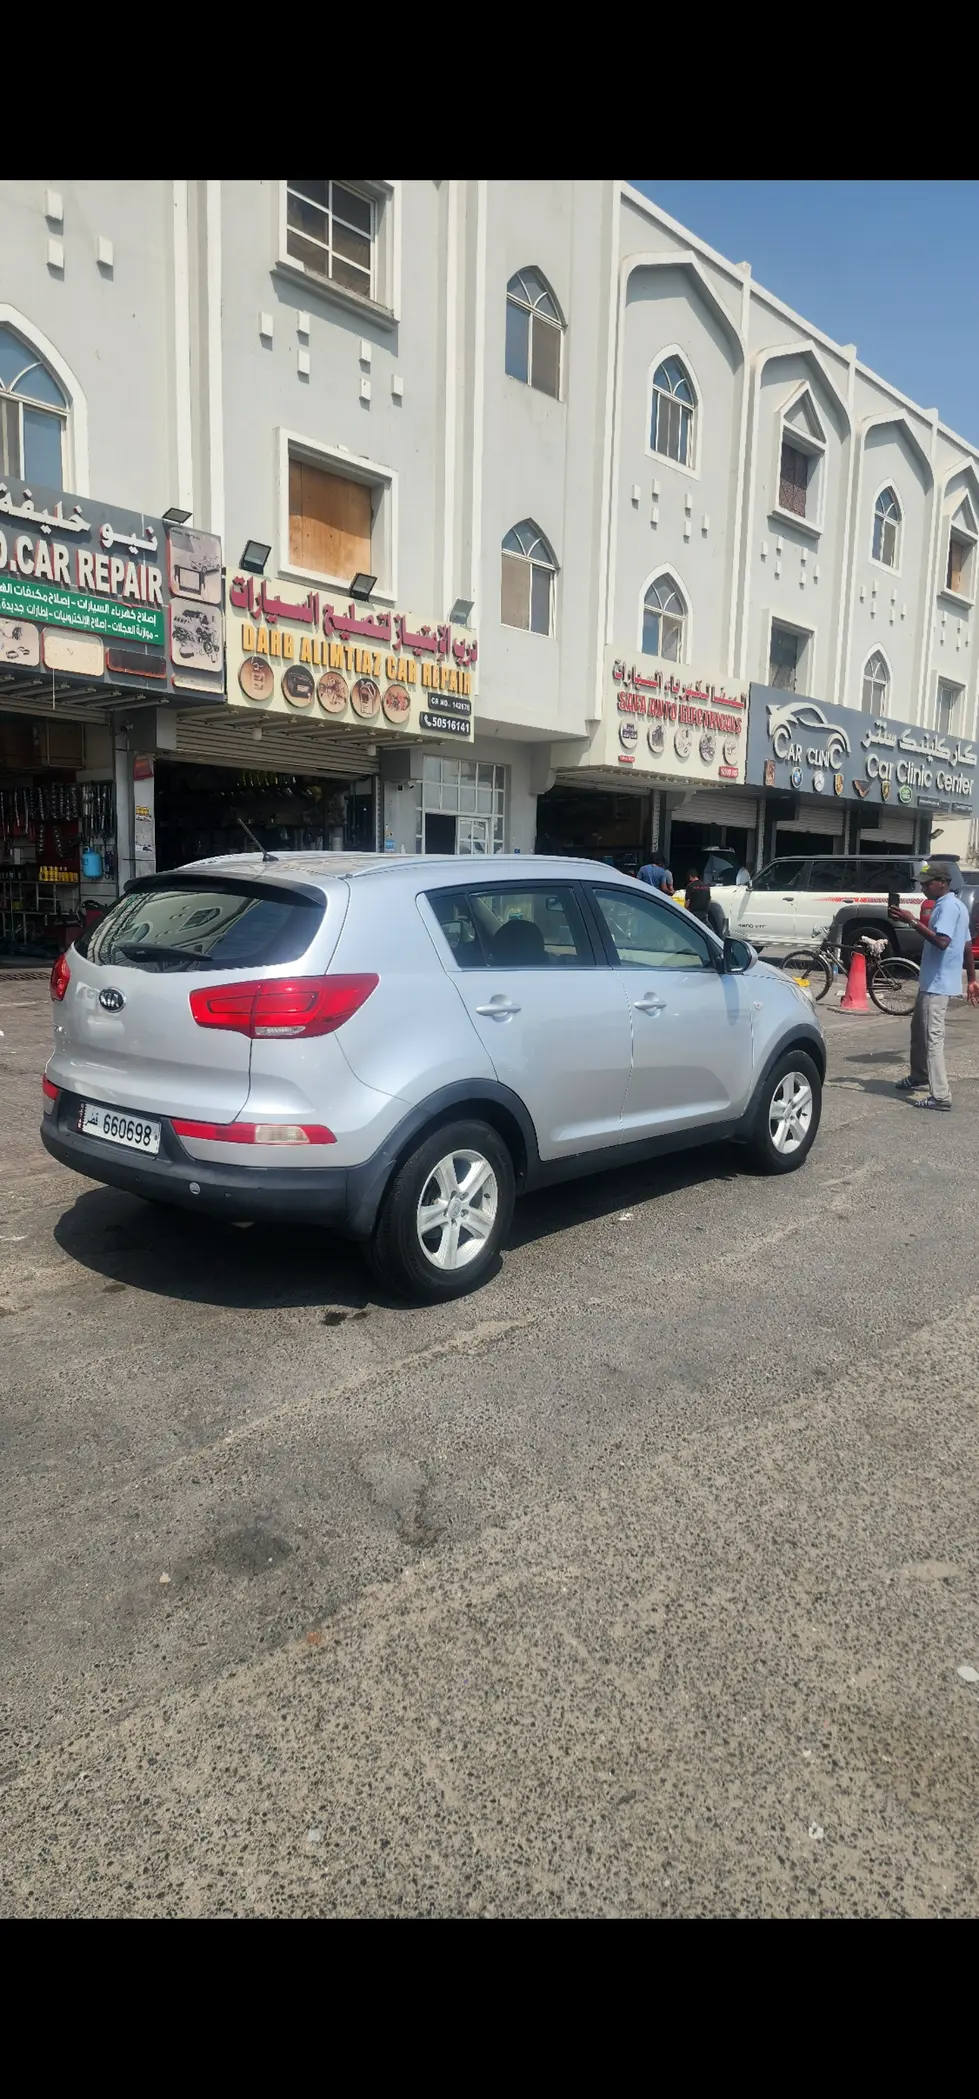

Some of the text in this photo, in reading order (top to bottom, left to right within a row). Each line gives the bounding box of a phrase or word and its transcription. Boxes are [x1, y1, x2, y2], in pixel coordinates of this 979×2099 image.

[101, 523, 158, 554] نيو
[77, 549, 163, 604] REPAIR
[2, 598, 24, 614] جديدة
[48, 592, 70, 608] إصلاح
[77, 599, 109, 614] السيارات
[111, 606, 136, 620] كهرباء
[230, 575, 319, 625] السيارات
[91, 618, 107, 632] إصلاح
[112, 623, 135, 635] العجلات
[136, 624, 153, 639] موازنة
[137, 612, 156, 626] إصلاح
[323, 603, 391, 642] لتصليح
[242, 624, 472, 695] DARB ALIMTIAZ CAR REPAIR
[453, 637, 478, 667] درب
[613, 659, 663, 690] السيارات
[431, 697, 439, 705] CR
[617, 691, 646, 714] SAFA
[648, 697, 677, 720] AUTO
[432, 717, 469, 733] 50516141
[806, 744, 843, 769] CLINIC
[861, 720, 977, 766] كار كلينيك سنتر
[866, 754, 974, 796] Car Clinic Center
[103, 1113, 152, 1146] 660698
